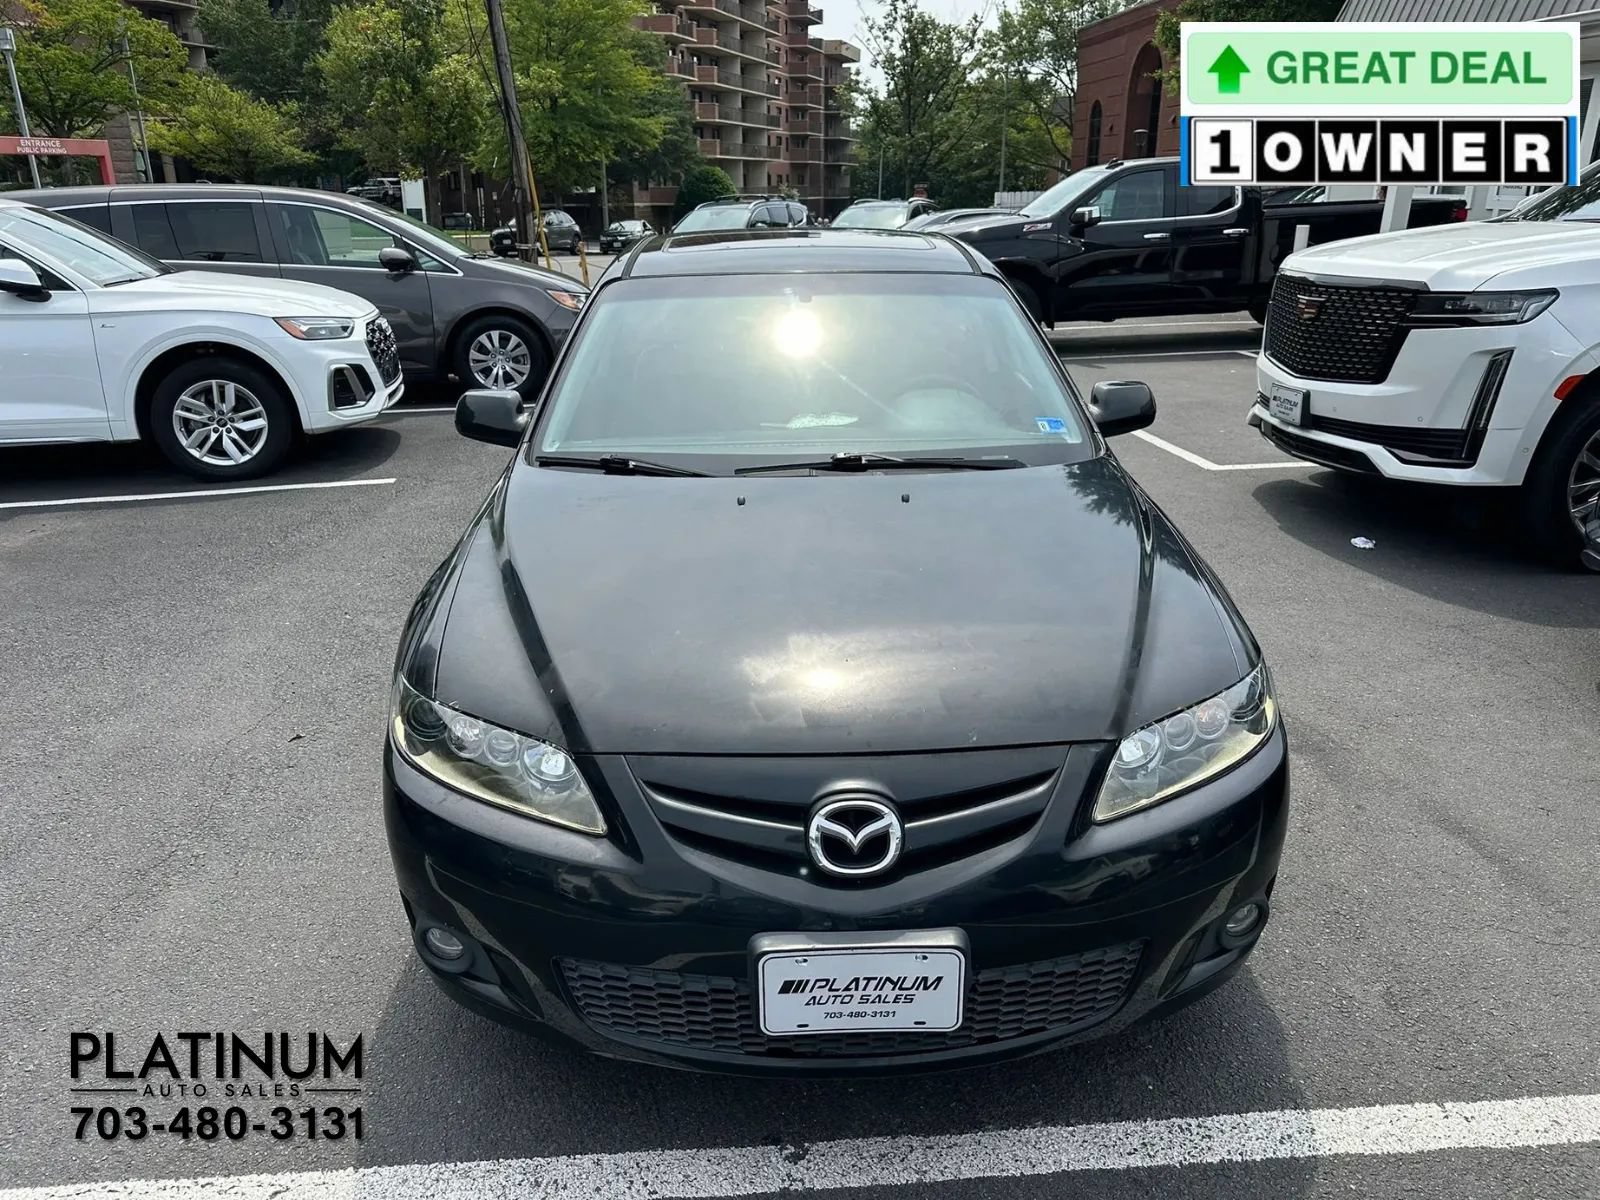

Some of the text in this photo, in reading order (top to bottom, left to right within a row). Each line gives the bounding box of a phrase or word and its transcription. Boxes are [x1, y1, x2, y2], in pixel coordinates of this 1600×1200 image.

[20, 139, 61, 147] ENTRANCE
[808, 975, 944, 993] PLATINUM
[804, 993, 916, 1006] AUTO SALES
[823, 1010, 897, 1019] 703-480-3131
